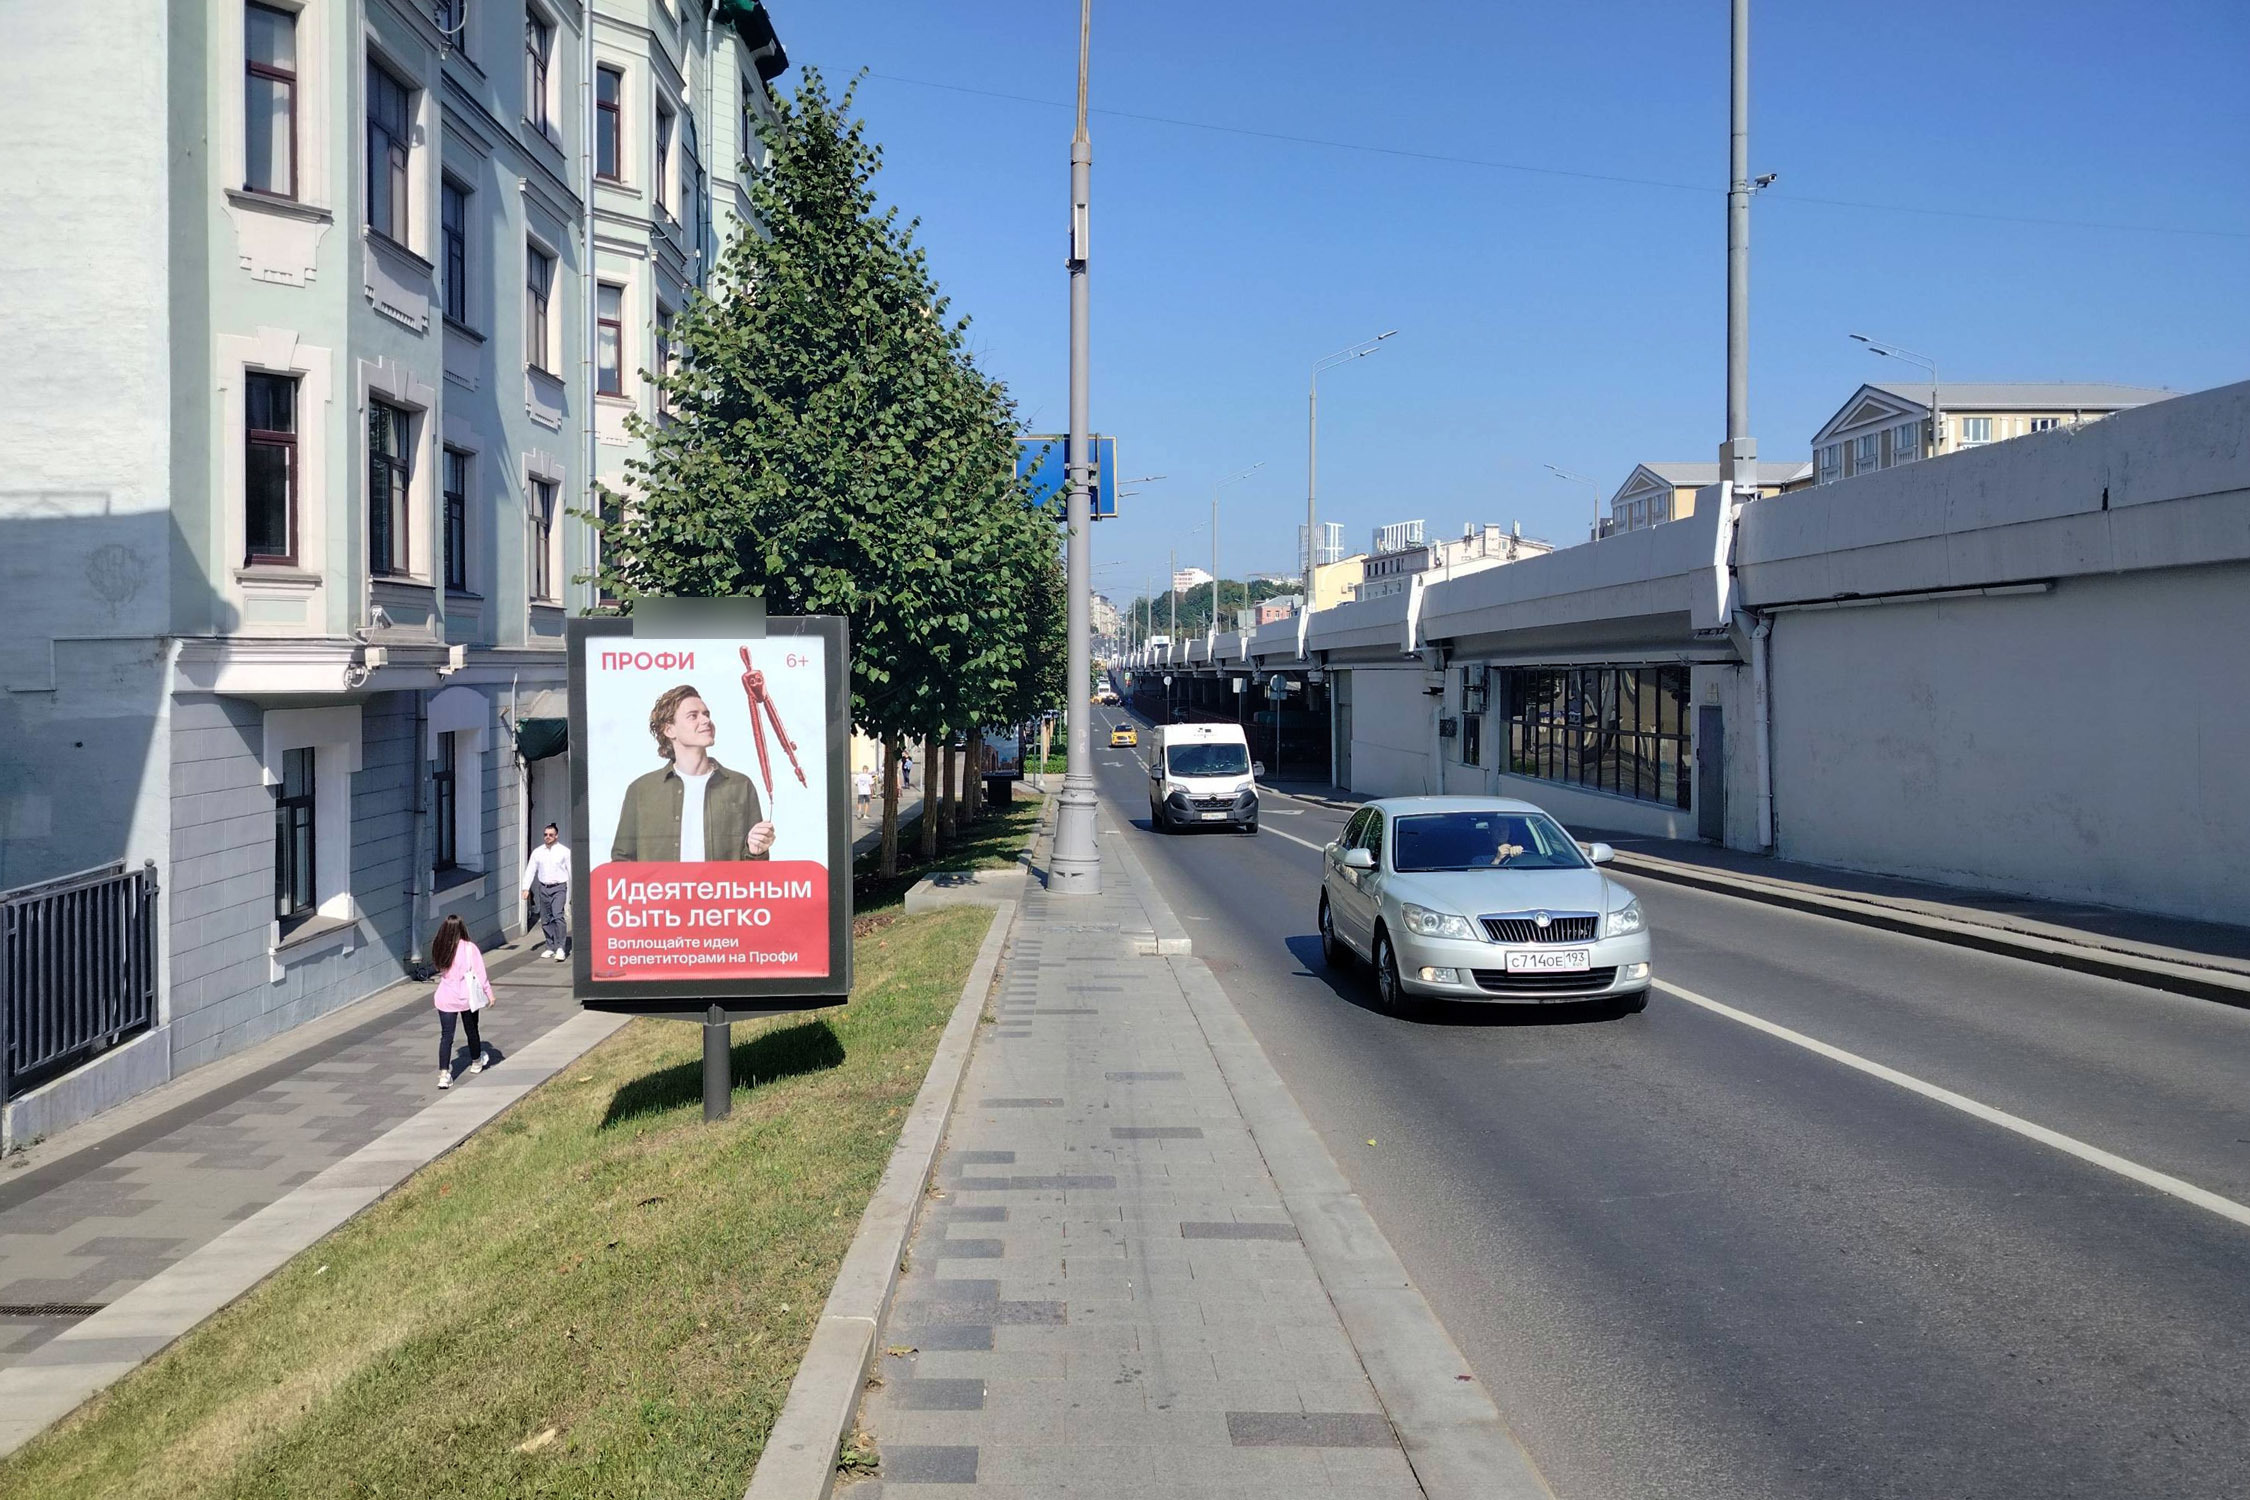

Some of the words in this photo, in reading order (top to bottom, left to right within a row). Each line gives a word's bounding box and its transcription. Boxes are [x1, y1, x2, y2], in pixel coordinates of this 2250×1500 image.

[602, 652, 694, 670] ПРОФИ
[786, 654, 809, 668] 6+
[607, 878, 811, 904] Идеятельным
[607, 906, 681, 928] быть
[687, 907, 771, 927] легко
[607, 936, 700, 950] Воплощайте
[703, 938, 739, 949] идеи
[607, 955, 616, 965] с
[619, 954, 726, 967] репетиторами
[728, 954, 746, 963] на
[749, 951, 798, 964] Профи
